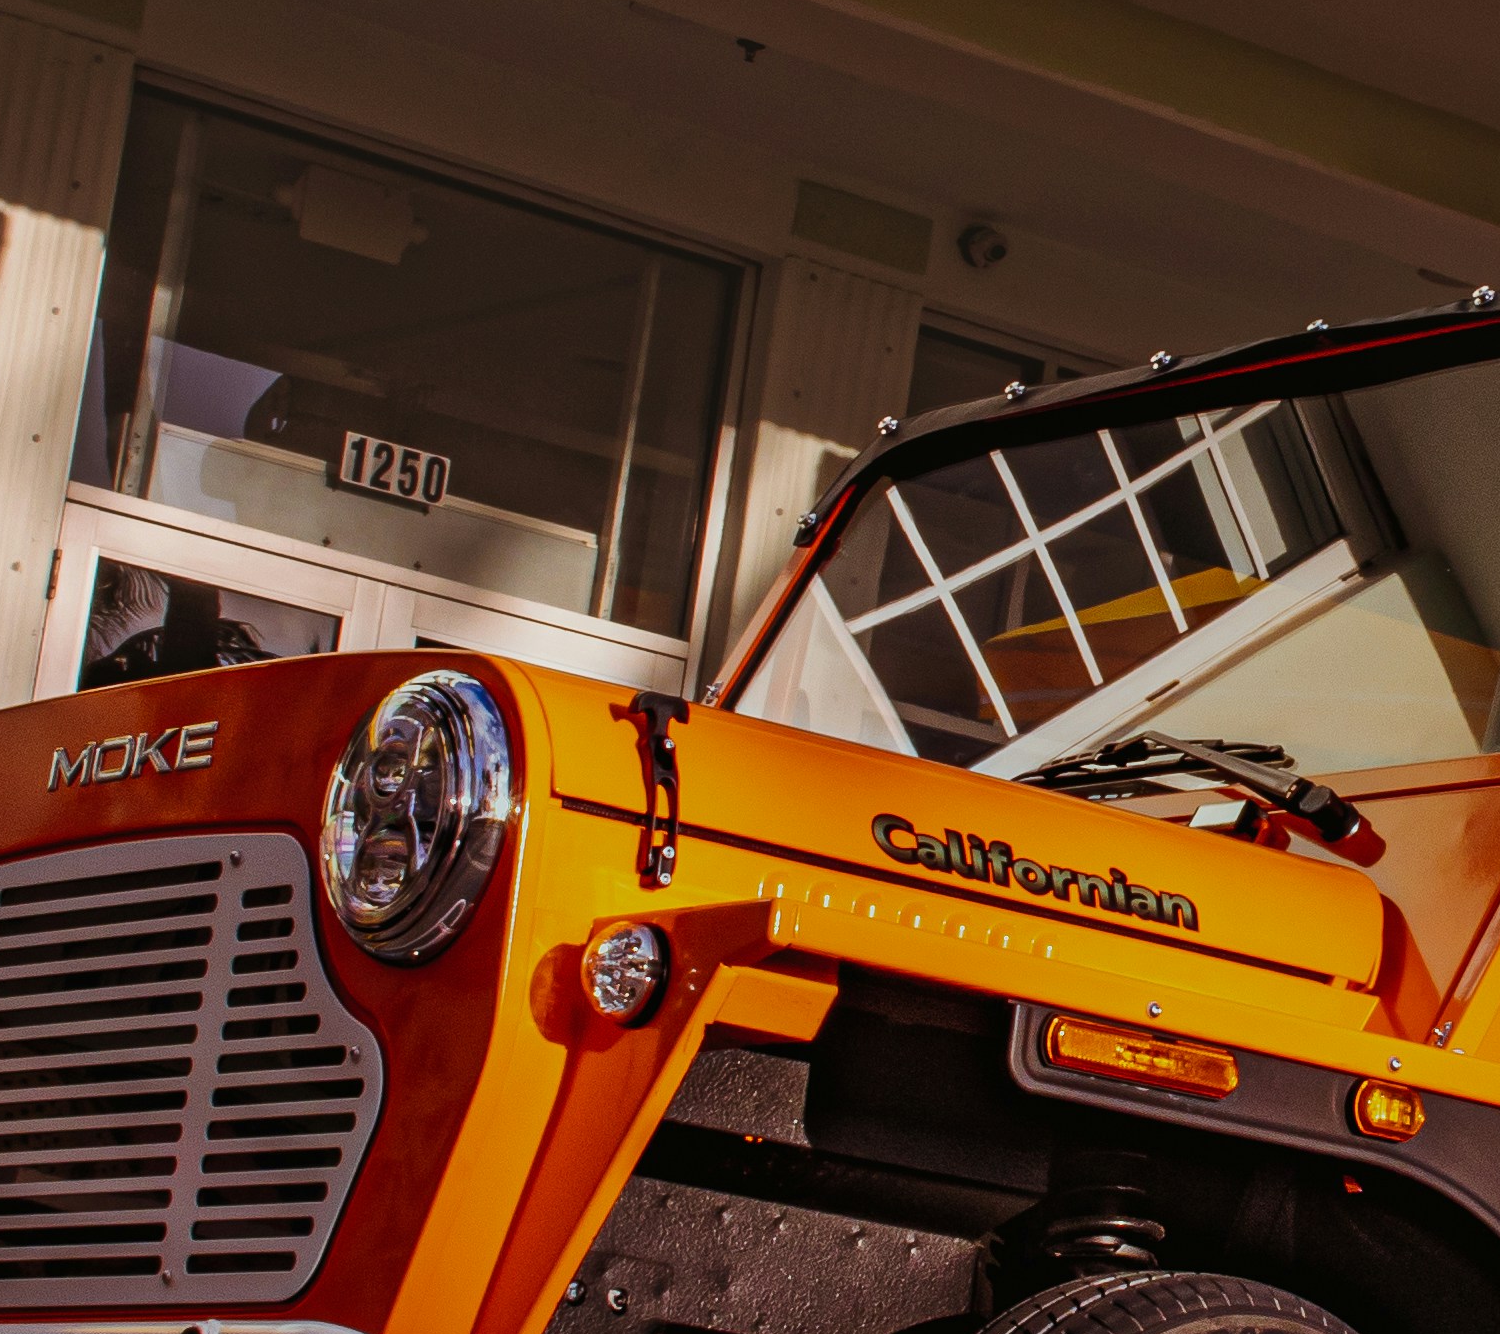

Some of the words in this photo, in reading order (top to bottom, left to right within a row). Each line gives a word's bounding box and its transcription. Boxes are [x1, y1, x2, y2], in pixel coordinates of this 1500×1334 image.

[350, 436, 448, 504] 1250
[47, 720, 219, 793] MOKE
[871, 812, 1200, 932] Californian
